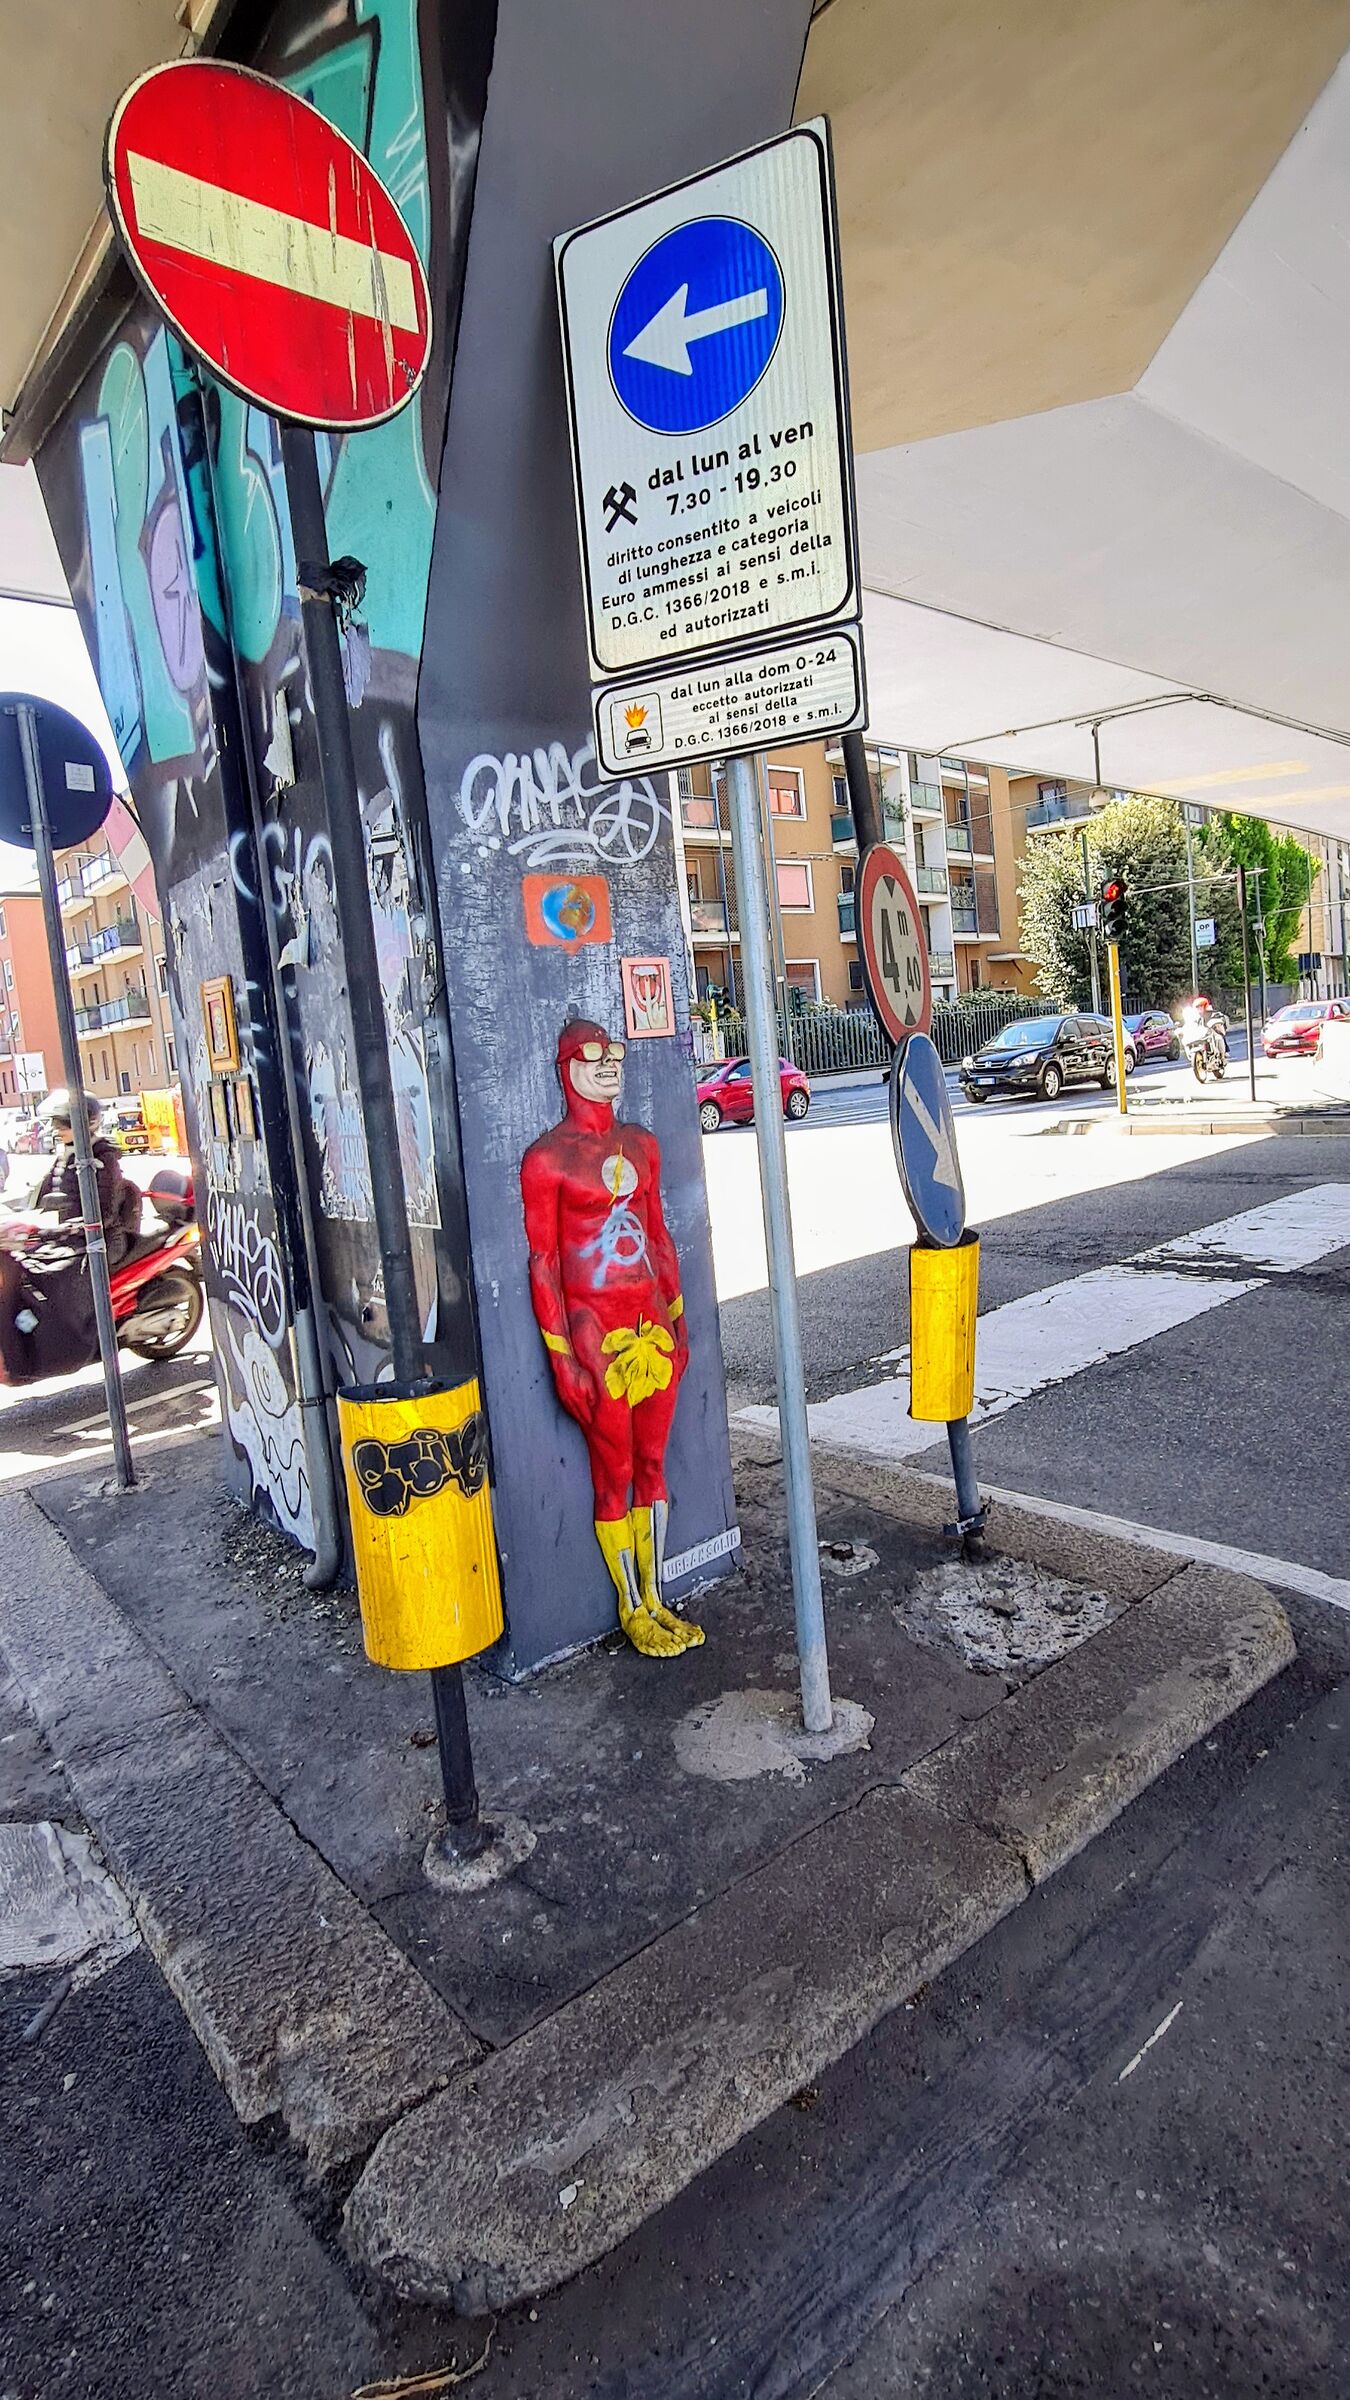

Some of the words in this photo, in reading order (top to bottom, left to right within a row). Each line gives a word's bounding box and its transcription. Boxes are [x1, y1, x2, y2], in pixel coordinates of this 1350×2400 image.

[648, 460, 684, 490] dal
[692, 450, 729, 476] lun
[738, 434, 762, 460] al
[769, 421, 814, 448] ven
[666, 488, 711, 515] 7.30
[734, 460, 797, 494] 19.30
[607, 545, 653, 567] diritto
[657, 518, 740, 552] consentito
[748, 513, 758, 524] a
[767, 489, 822, 518] veicoli
[618, 569, 632, 585] di
[637, 549, 712, 580] lunghezza
[717, 545, 726, 555] e
[731, 519, 809, 551] categoria
[602, 592, 635, 610] Euro
[643, 567, 708, 598] ammessi
[717, 561, 731, 577] ai
[739, 546, 781, 570] sensi
[790, 534, 832, 556] della
[612, 607, 659, 630] D.G.C.
[665, 580, 750, 615] 1366/2018
[759, 578, 768, 589] e
[777, 561, 820, 584] s.m.i.
[660, 624, 677, 640] ed
[685, 598, 769, 633] autorizzati
[670, 684, 693, 700] dal
[698, 679, 720, 695] lun
[725, 671, 753, 687] alla
[758, 662, 790, 679] dom
[692, 695, 738, 713] eccetto
[744, 675, 813, 701] autorizzati
[674, 731, 714, 749] D.G.C.
[718, 715, 786, 740] 1366/2018
[792, 713, 800, 723] e
[807, 703, 842, 720] s.m.i.
[709, 711, 720, 724] ai
[726, 703, 759, 720] sensi
[765, 695, 798, 712] della
